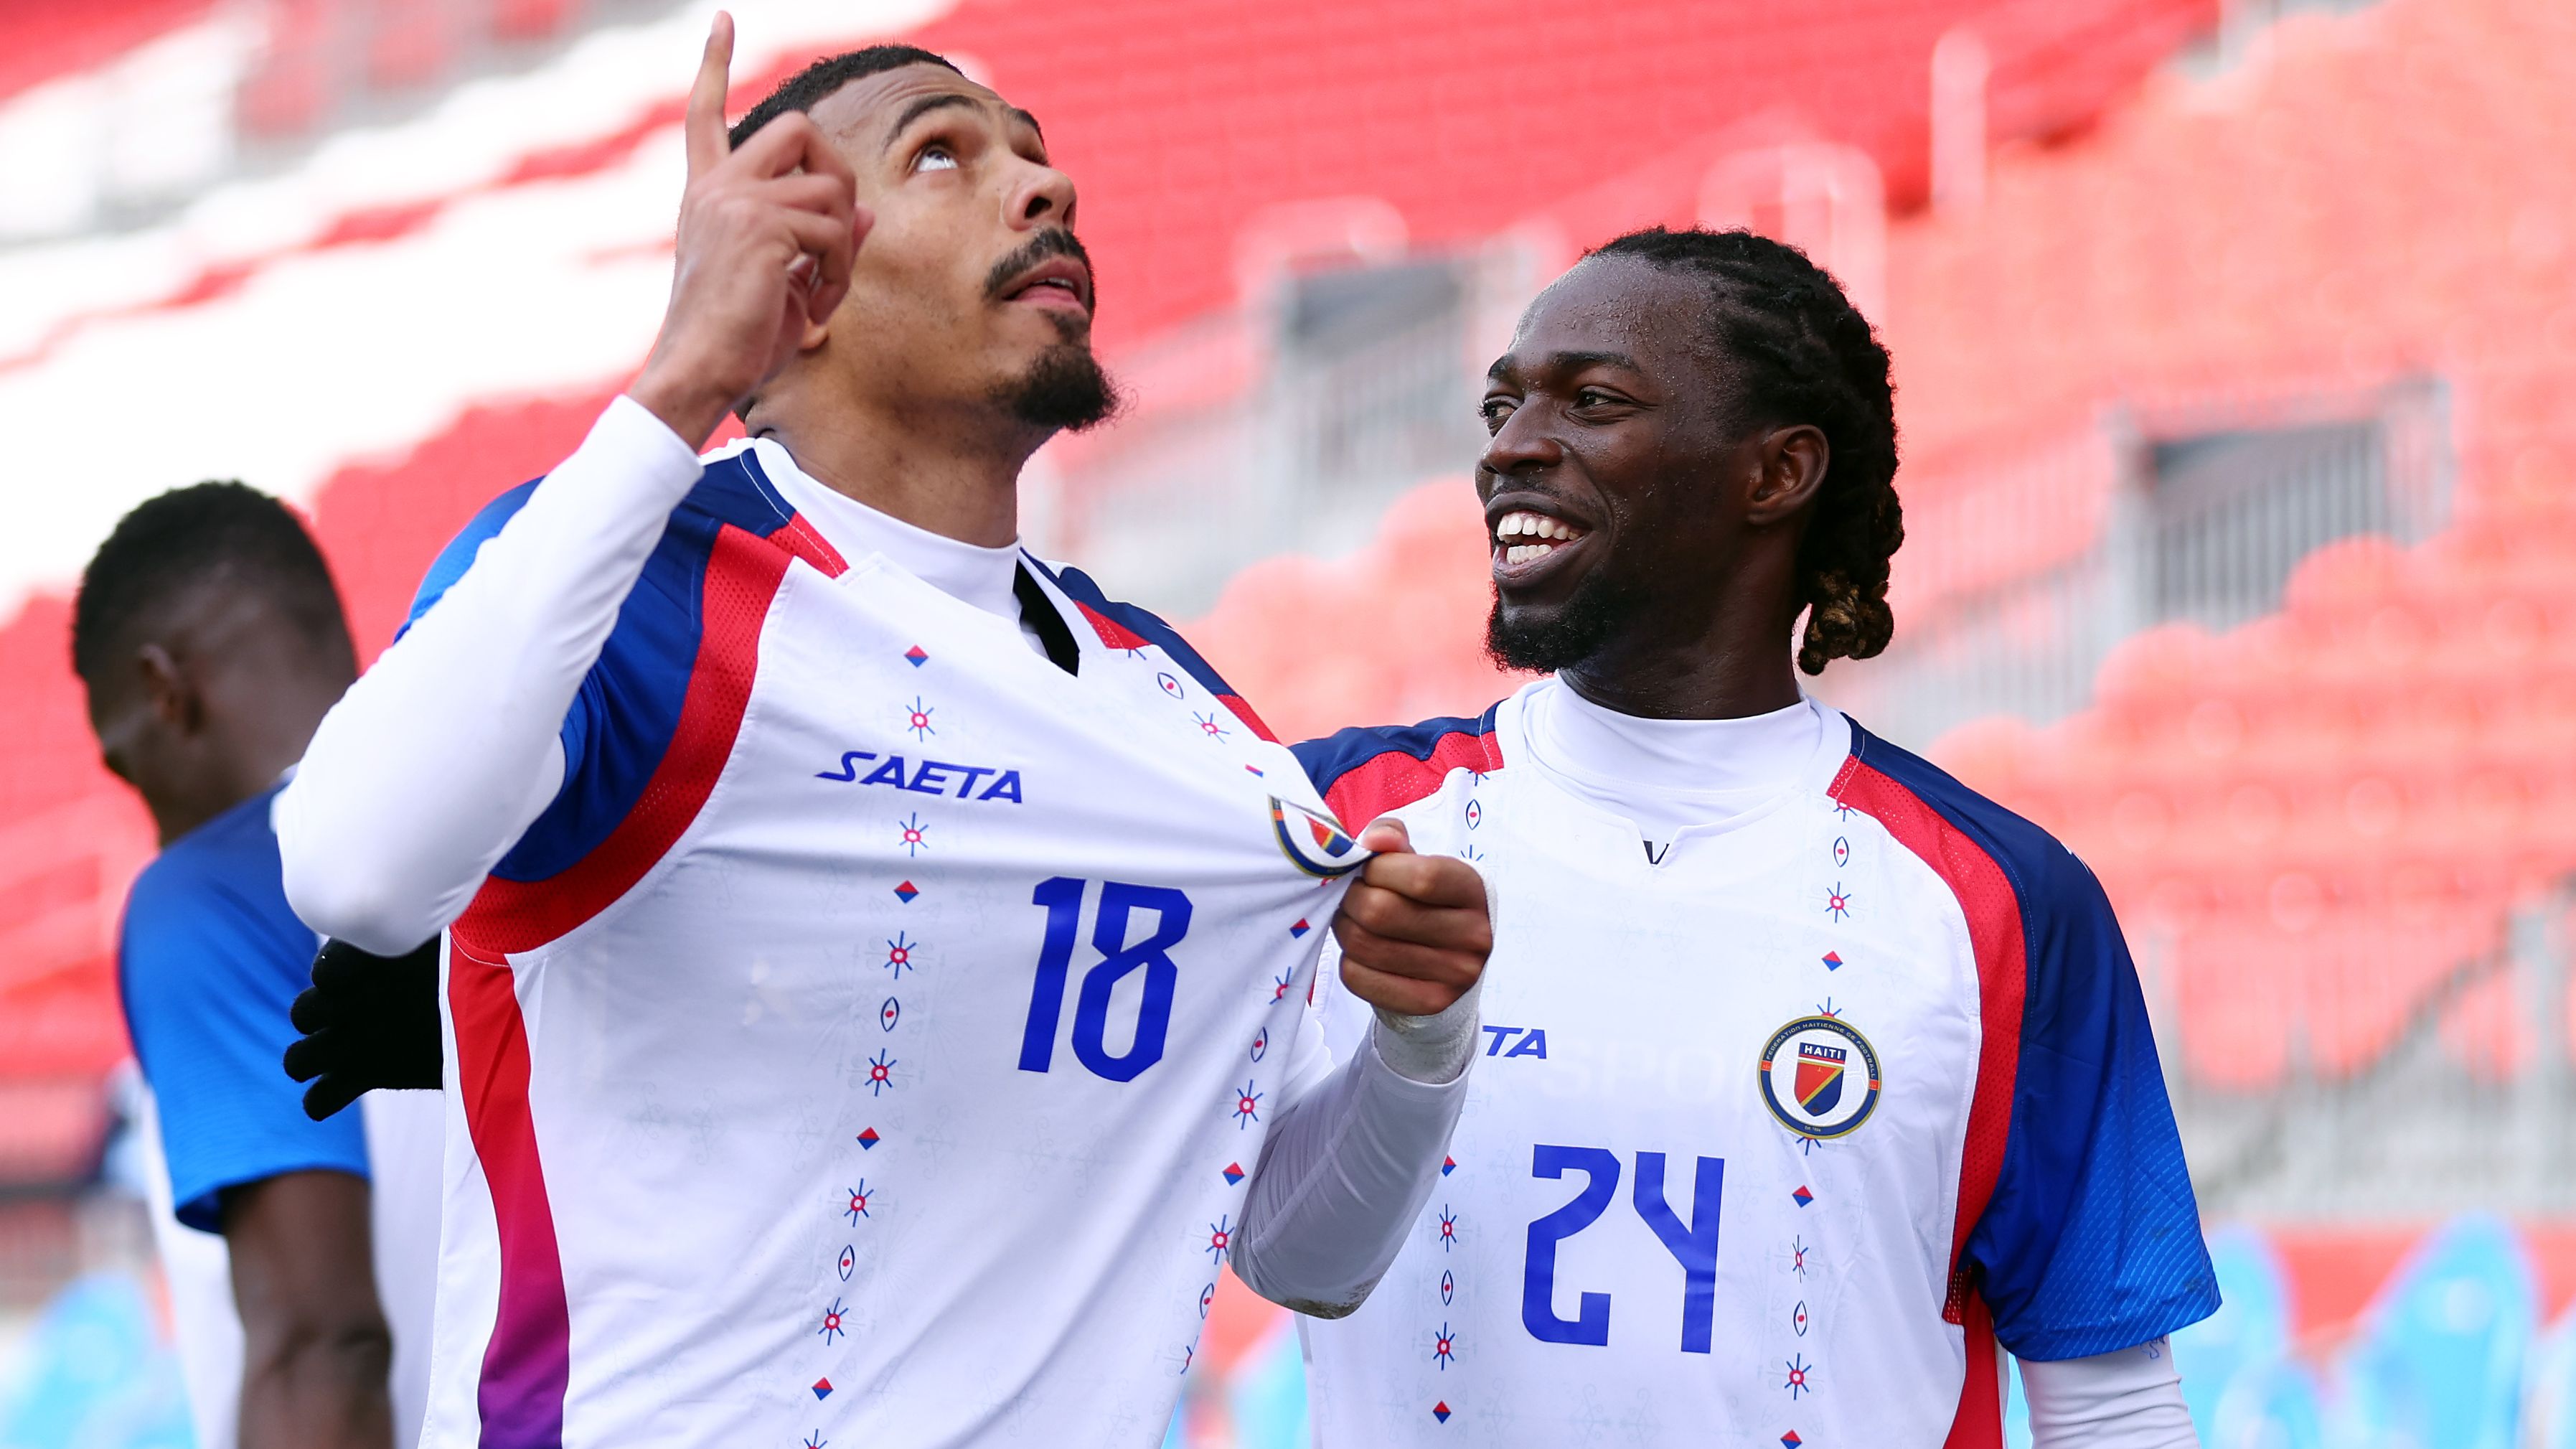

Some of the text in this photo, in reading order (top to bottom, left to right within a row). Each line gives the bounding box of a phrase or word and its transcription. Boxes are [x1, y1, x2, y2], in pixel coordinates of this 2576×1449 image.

[814, 751, 1022, 804] SAETA
[1018, 876, 1193, 1082] 18
[1804, 1045, 1841, 1059] HAITI
[1522, 1144, 1724, 1354] 24
